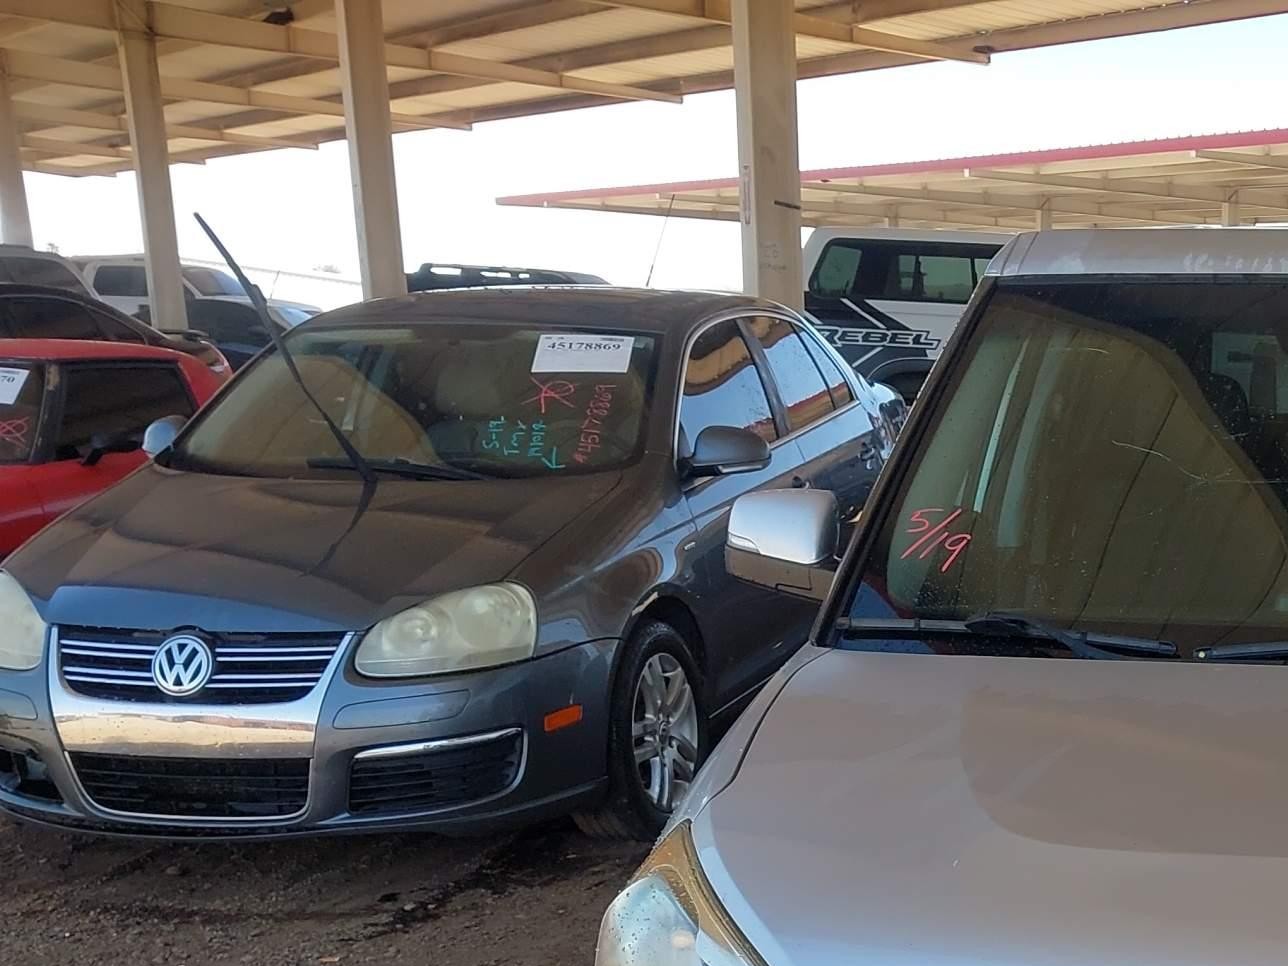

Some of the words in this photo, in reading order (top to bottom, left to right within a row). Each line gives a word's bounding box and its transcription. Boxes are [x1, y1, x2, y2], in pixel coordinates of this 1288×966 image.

[547, 341, 622, 351] 45178869
[813, 325, 942, 350] REBEL
[900, 506, 972, 573] 5/19
[156, 638, 207, 691] VW
